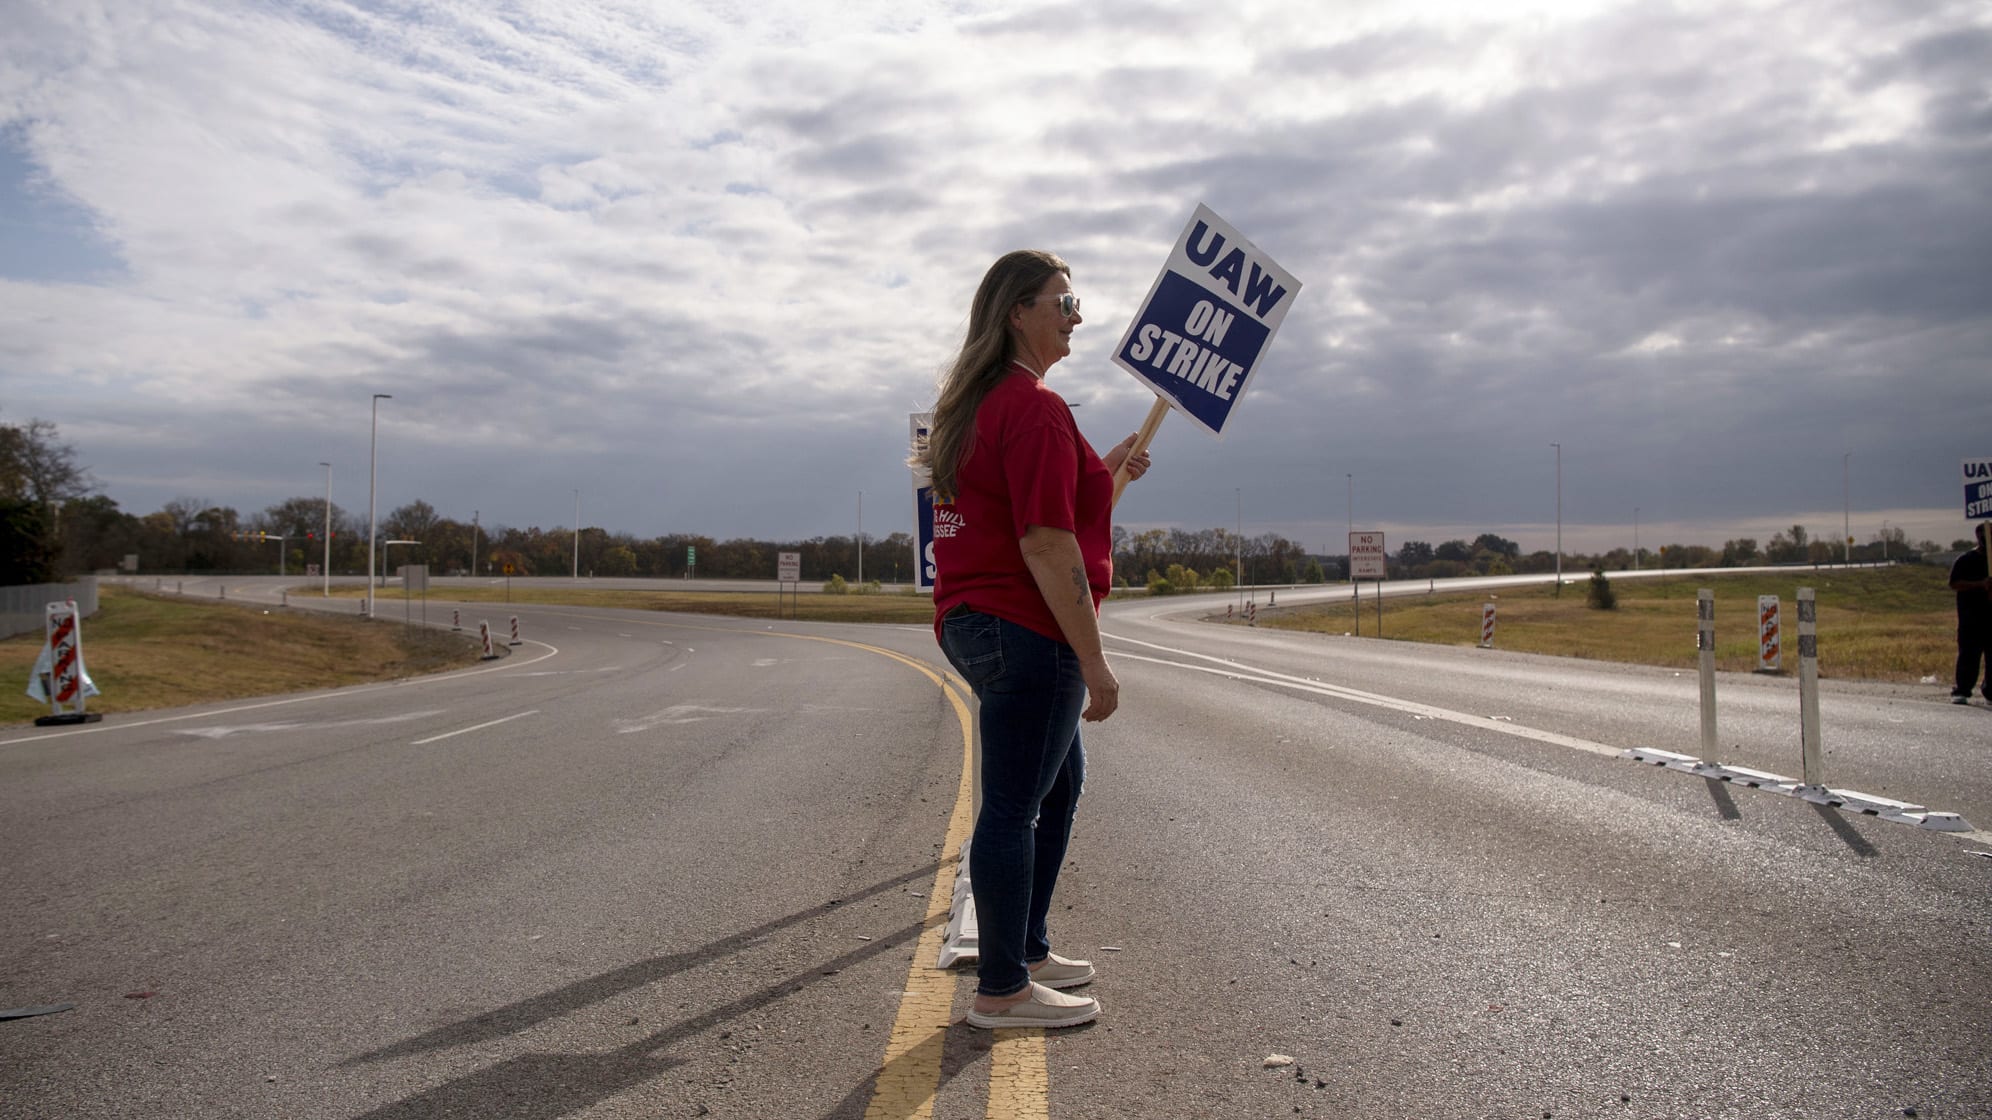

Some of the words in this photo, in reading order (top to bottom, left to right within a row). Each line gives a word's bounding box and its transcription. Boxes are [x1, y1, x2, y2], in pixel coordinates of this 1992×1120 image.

[1185, 219, 1287, 319] UAW
[1185, 300, 1234, 347] ON
[1130, 323, 1244, 400] STRIKE
[1964, 463, 1992, 478] UA
[1968, 497, 1992, 517] STRI
[939, 510, 966, 527] HILL
[1360, 535, 1373, 544] NO
[1351, 545, 1382, 553] PARKING
